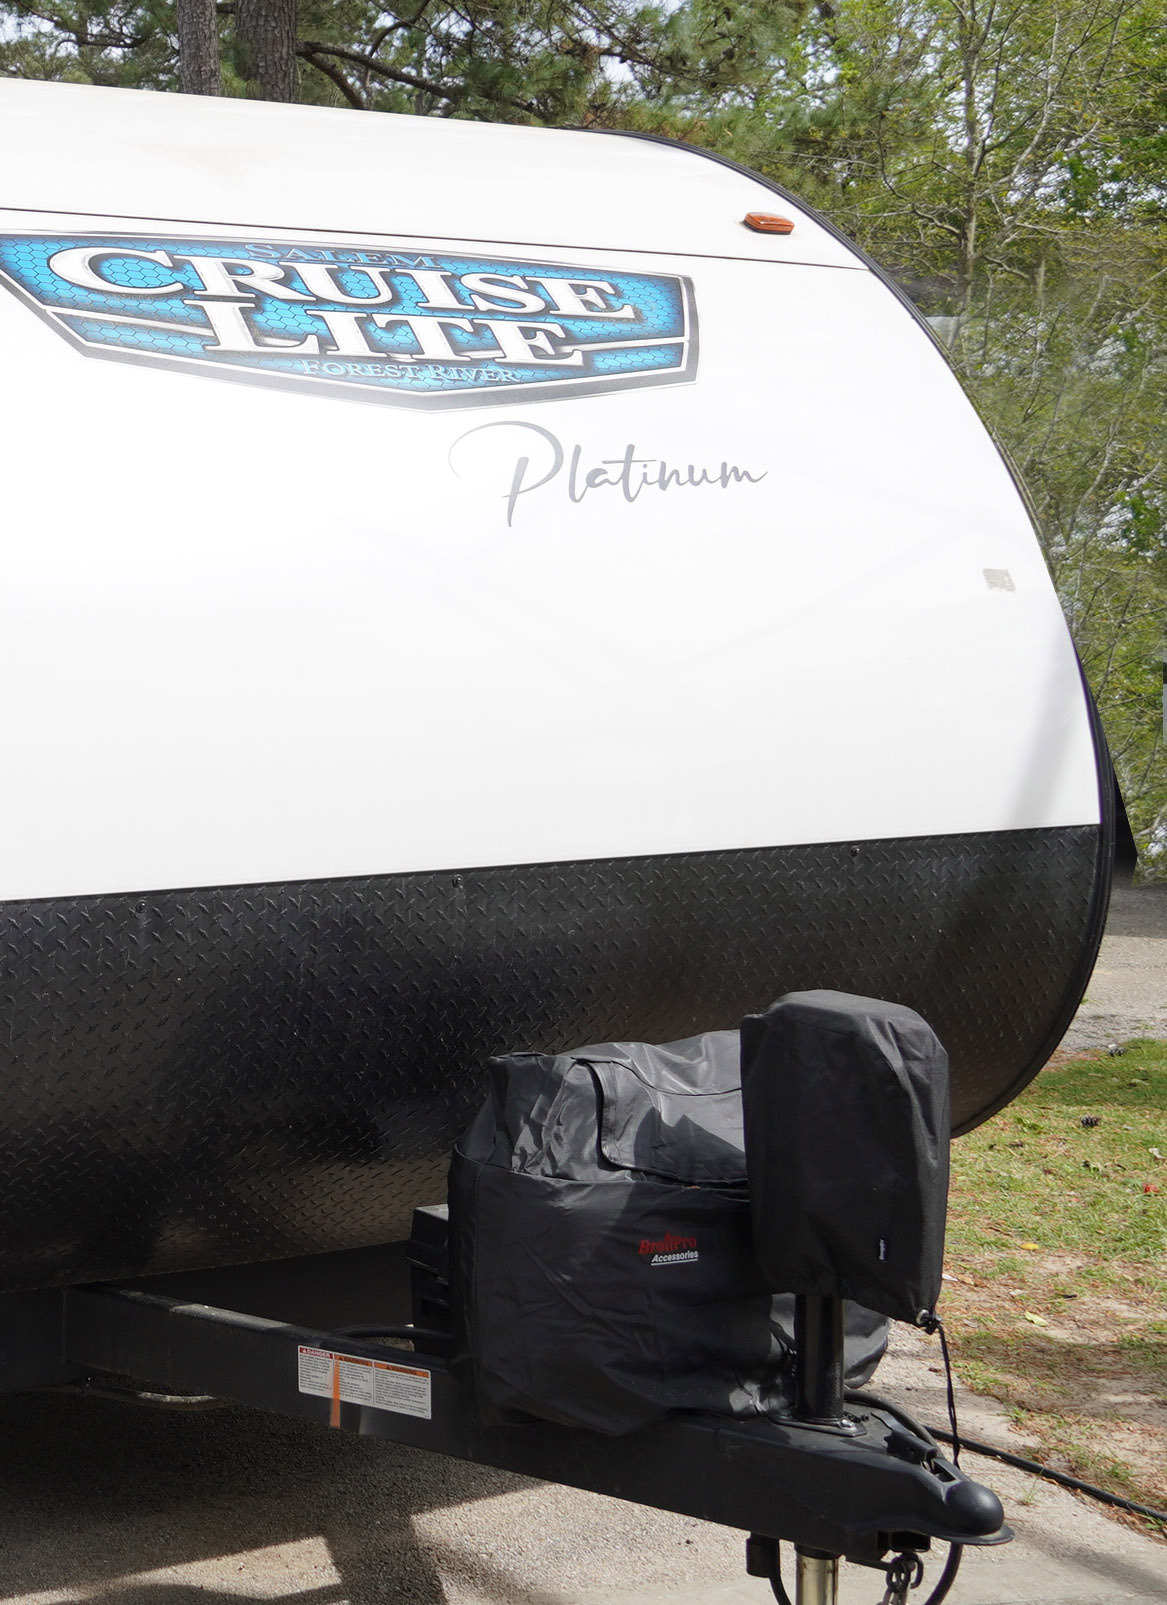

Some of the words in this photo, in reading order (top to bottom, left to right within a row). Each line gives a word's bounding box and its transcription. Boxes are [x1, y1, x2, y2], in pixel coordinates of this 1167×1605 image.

[245, 242, 440, 270] SALEM
[48, 245, 636, 319] CRUISE
[182, 299, 584, 367] LITE
[300, 357, 419, 382] FOREST
[425, 362, 522, 384] RIVER
[447, 420, 768, 527] Platinum
[651, 1250, 698, 1262] Accessories
[307, 1349, 330, 1359] DANGER
